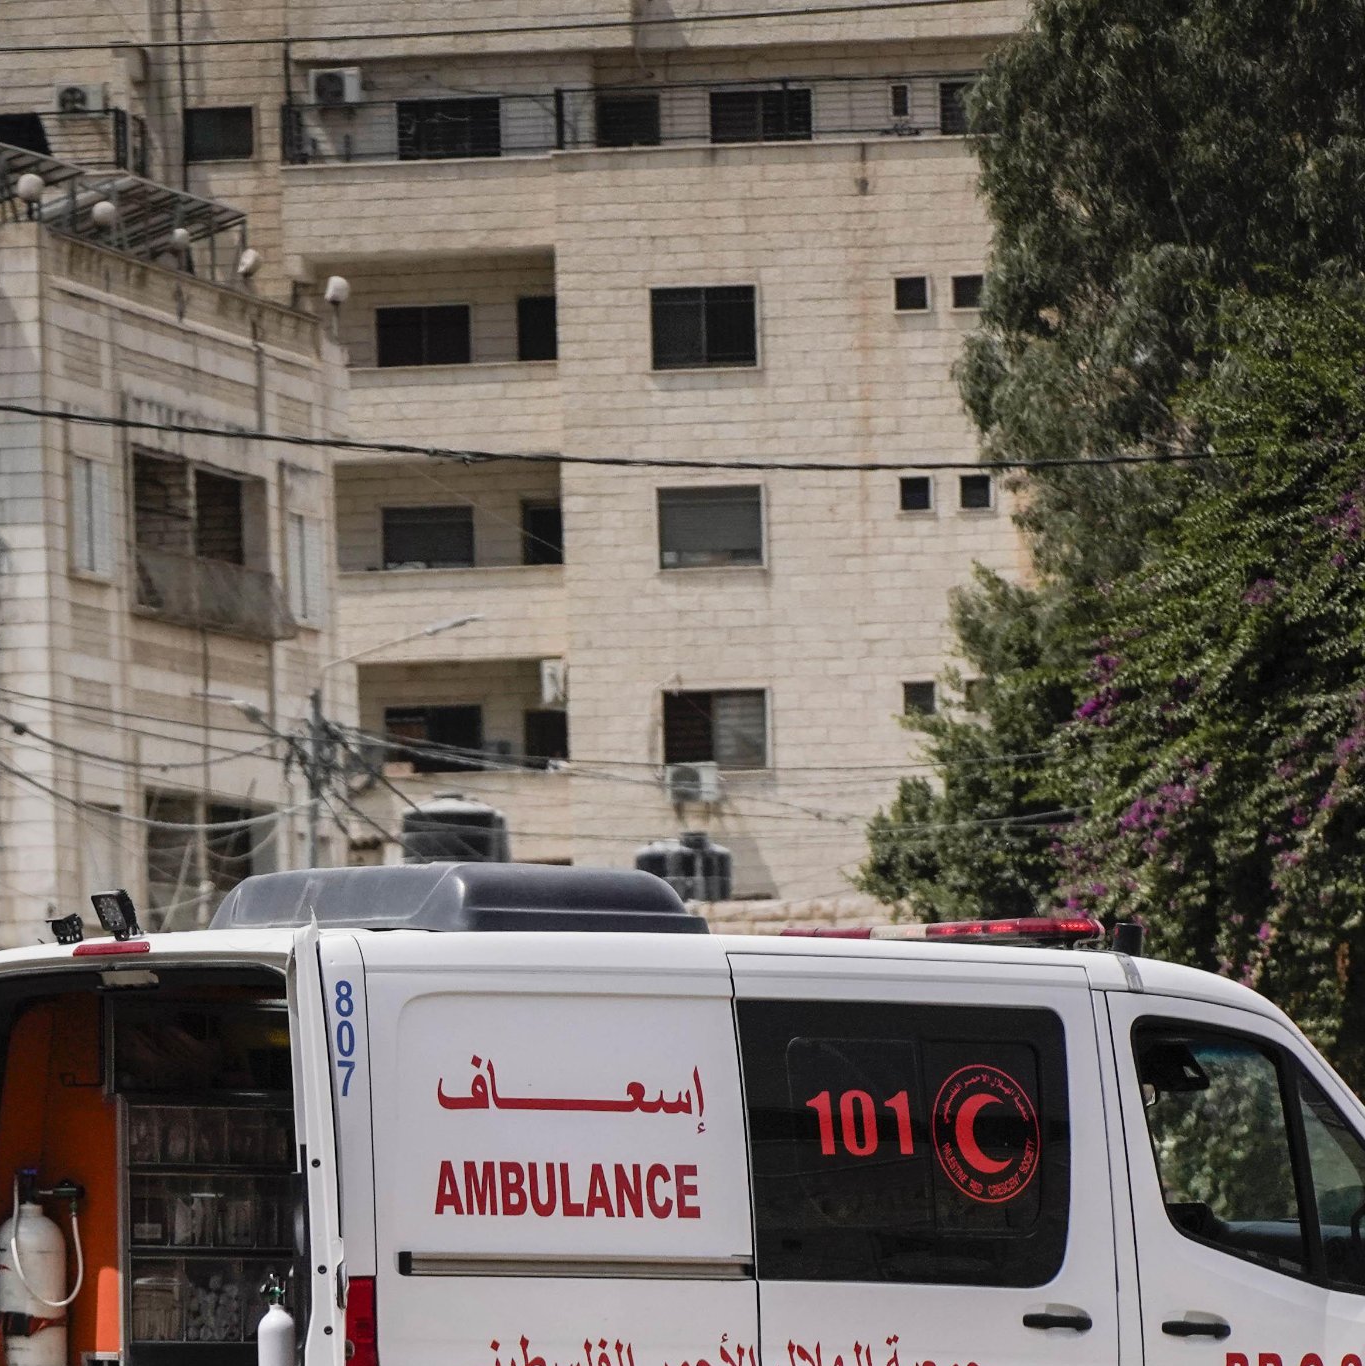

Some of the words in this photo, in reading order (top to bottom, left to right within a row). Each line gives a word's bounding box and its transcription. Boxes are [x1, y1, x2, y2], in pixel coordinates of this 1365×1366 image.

[335, 979, 356, 1097] 807
[437, 1054, 706, 1134] إسعاف
[805, 1089, 915, 1157] 101
[434, 1160, 701, 1220] AMBULANCE
[943, 1142, 968, 1183] PALESTINE
[970, 1179, 983, 1195] RED
[987, 1173, 1022, 1197] CRESCENT
[1019, 1137, 1036, 1174] SOCIETY
